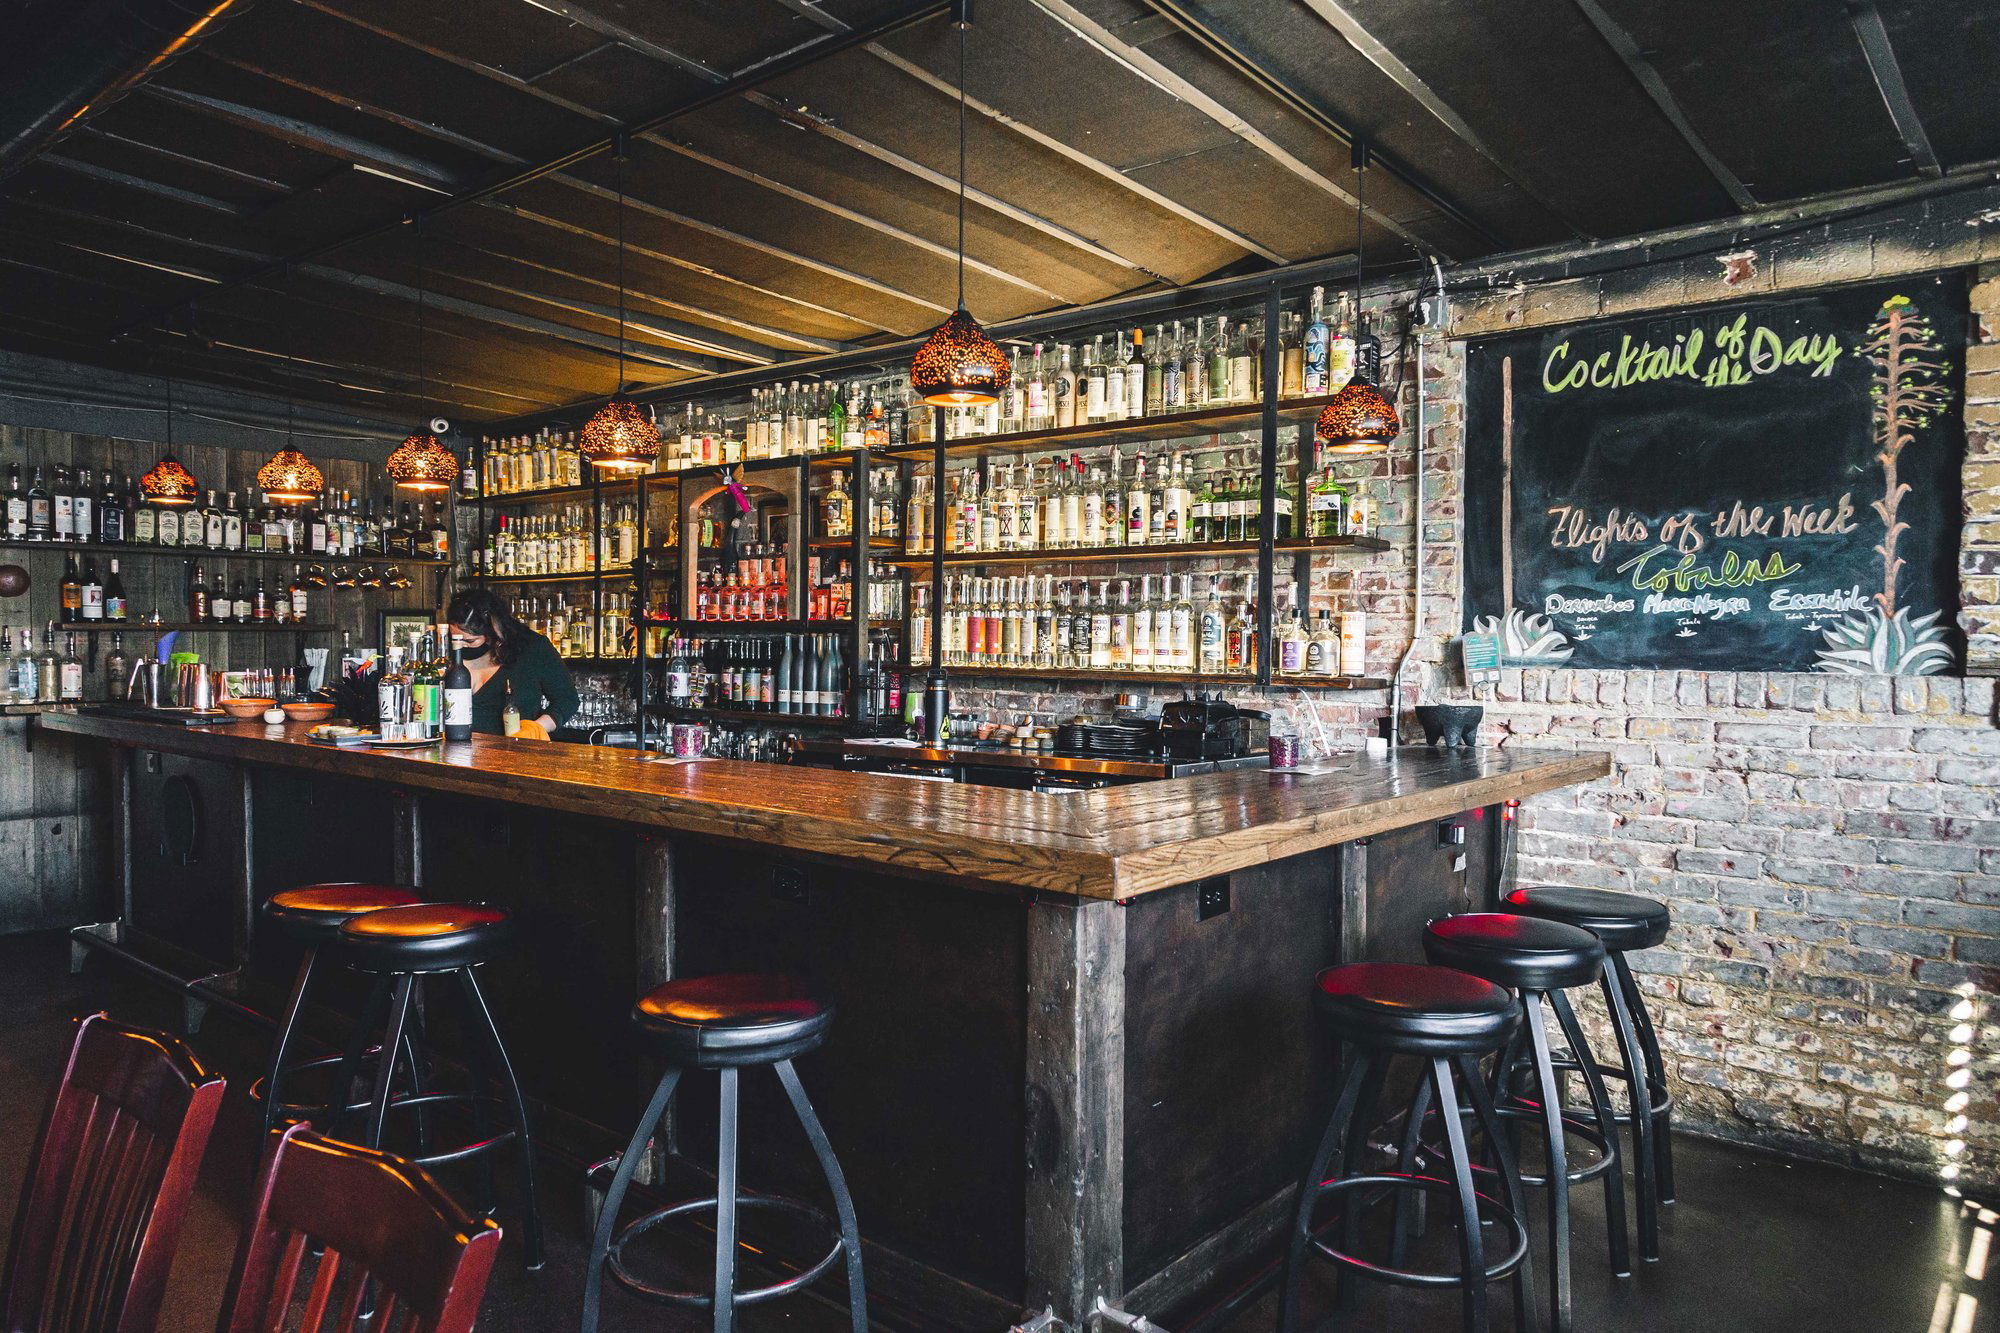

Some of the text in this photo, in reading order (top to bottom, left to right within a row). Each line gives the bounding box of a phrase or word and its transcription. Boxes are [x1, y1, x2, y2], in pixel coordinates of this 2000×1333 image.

[1543, 328, 1704, 393] Cocktail
[1715, 312, 1747, 360] of
[1749, 326, 1843, 377] Day
[1701, 355, 1753, 387] the
[1548, 492, 1860, 563] Flights of the Week
